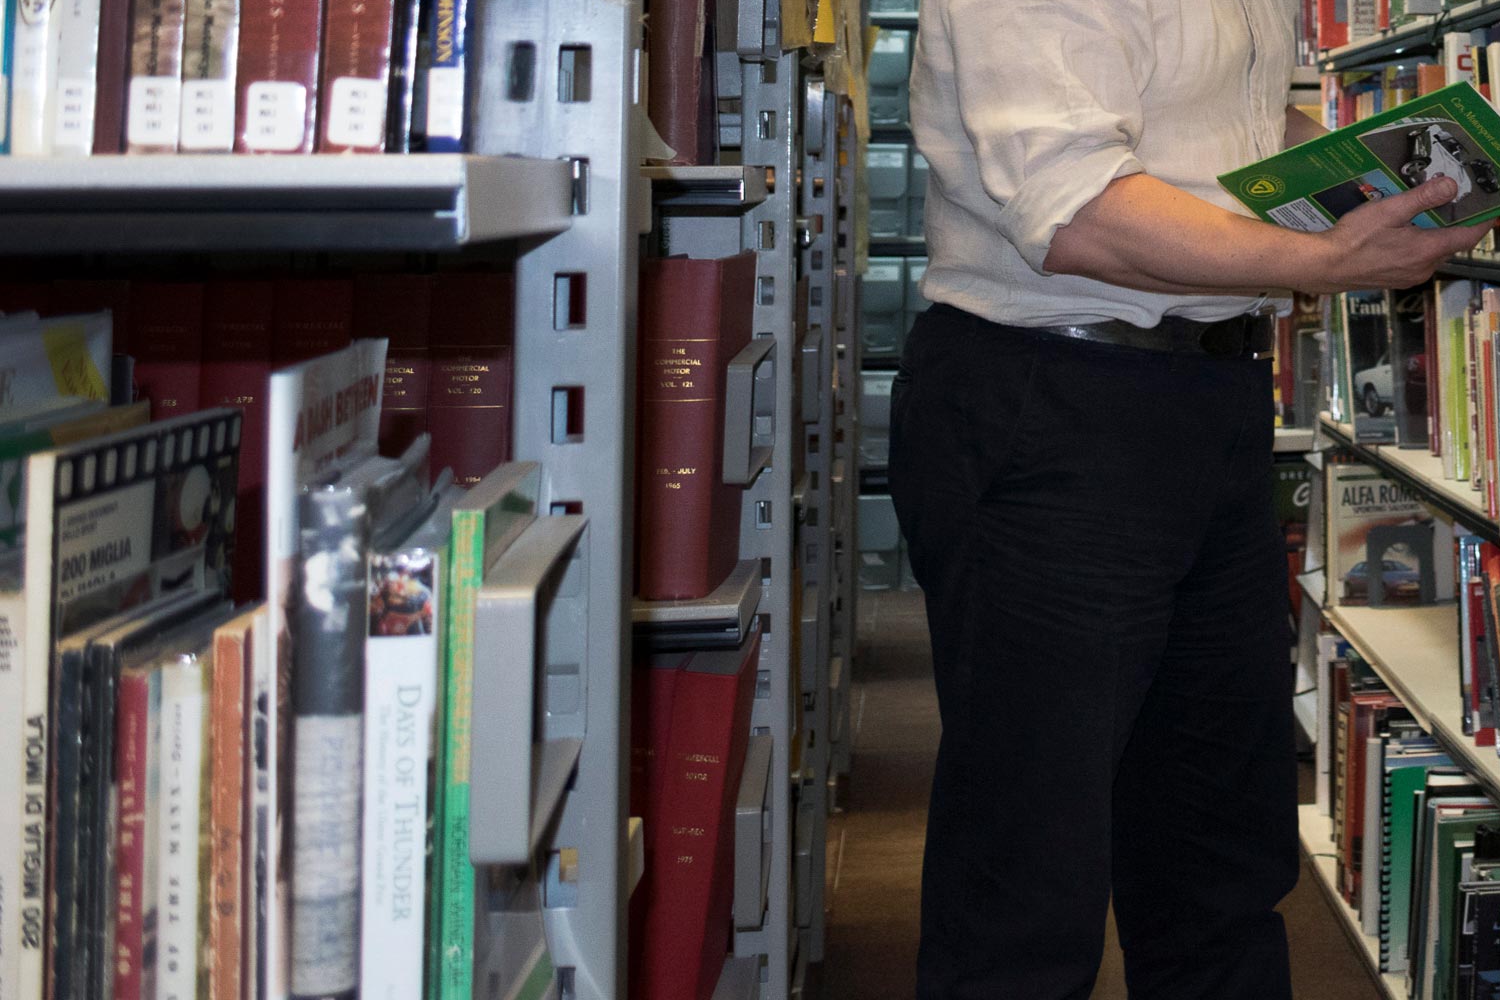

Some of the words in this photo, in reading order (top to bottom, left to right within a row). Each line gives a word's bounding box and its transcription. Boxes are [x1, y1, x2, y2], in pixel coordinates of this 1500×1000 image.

[654, 358, 702, 367] COMMERCIAL
[663, 367, 690, 375] MOTOR
[677, 467, 696, 475] JULY
[60, 550, 87, 584] 200
[90, 536, 133, 574] MIGLIA
[396, 685, 422, 748] DAYS
[25, 714, 45, 786] IMOLA
[394, 757, 417, 787] OF
[25, 794, 44, 815] DI
[22, 825, 44, 899] MIGLIA
[391, 794, 420, 921] THUNDER
[22, 907, 42, 950] 200
